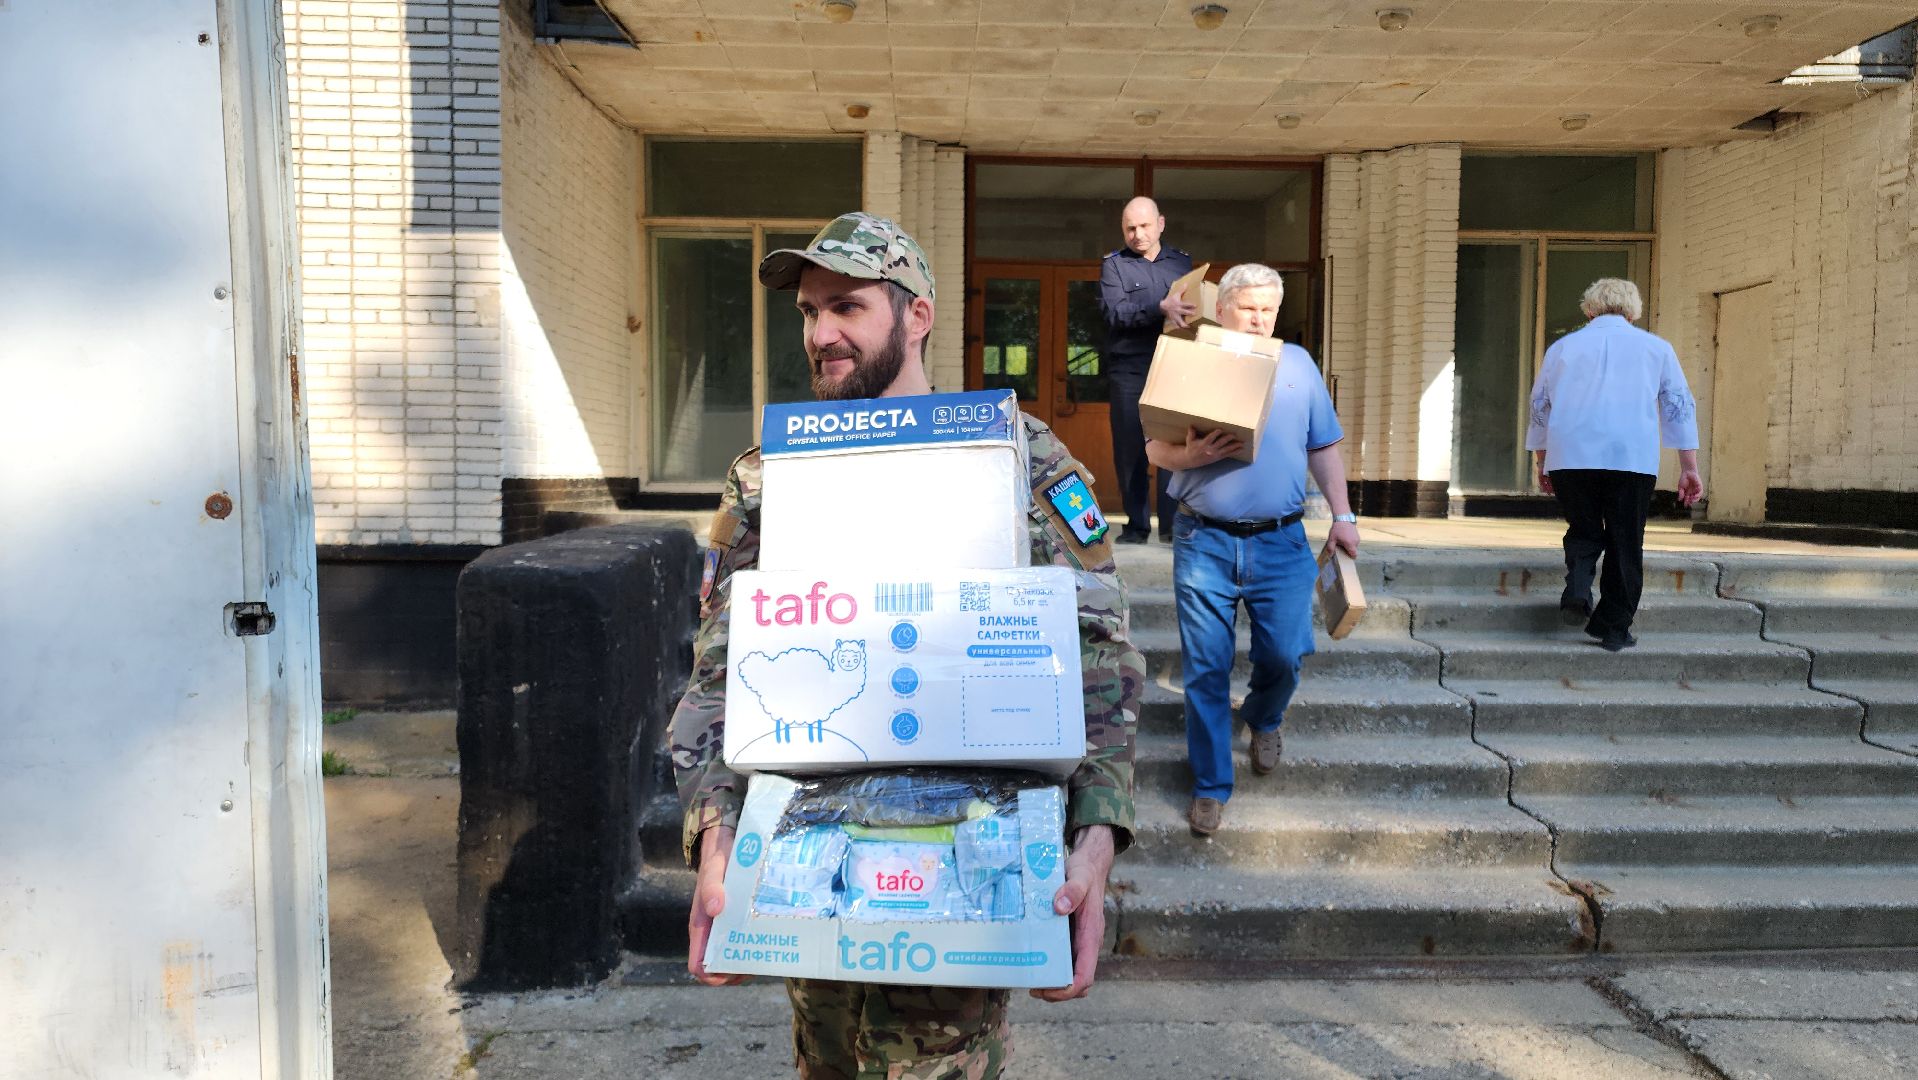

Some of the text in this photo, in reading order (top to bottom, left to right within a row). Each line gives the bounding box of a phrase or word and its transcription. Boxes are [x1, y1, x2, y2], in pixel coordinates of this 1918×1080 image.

[787, 408, 918, 435] PROJECTA
[786, 431, 897, 446] CRYSTAL WHITE OFFICE PAPER
[1048, 474, 1080, 499] КАШИРА
[750, 581, 858, 627] tafo
[1013, 597, 1026, 608] 6,5
[979, 616, 1038, 627] ВЛАЖНЫЕ
[977, 630, 1041, 641] САЛФЕТКИ
[971, 647, 1047, 657] универсальные
[741, 838, 758, 856] 20
[876, 869, 924, 892] tafo
[728, 930, 799, 947] ВЛАЖНЫЕ
[723, 947, 800, 964] САЛФЕТКИ
[838, 931, 937, 973] tafo
